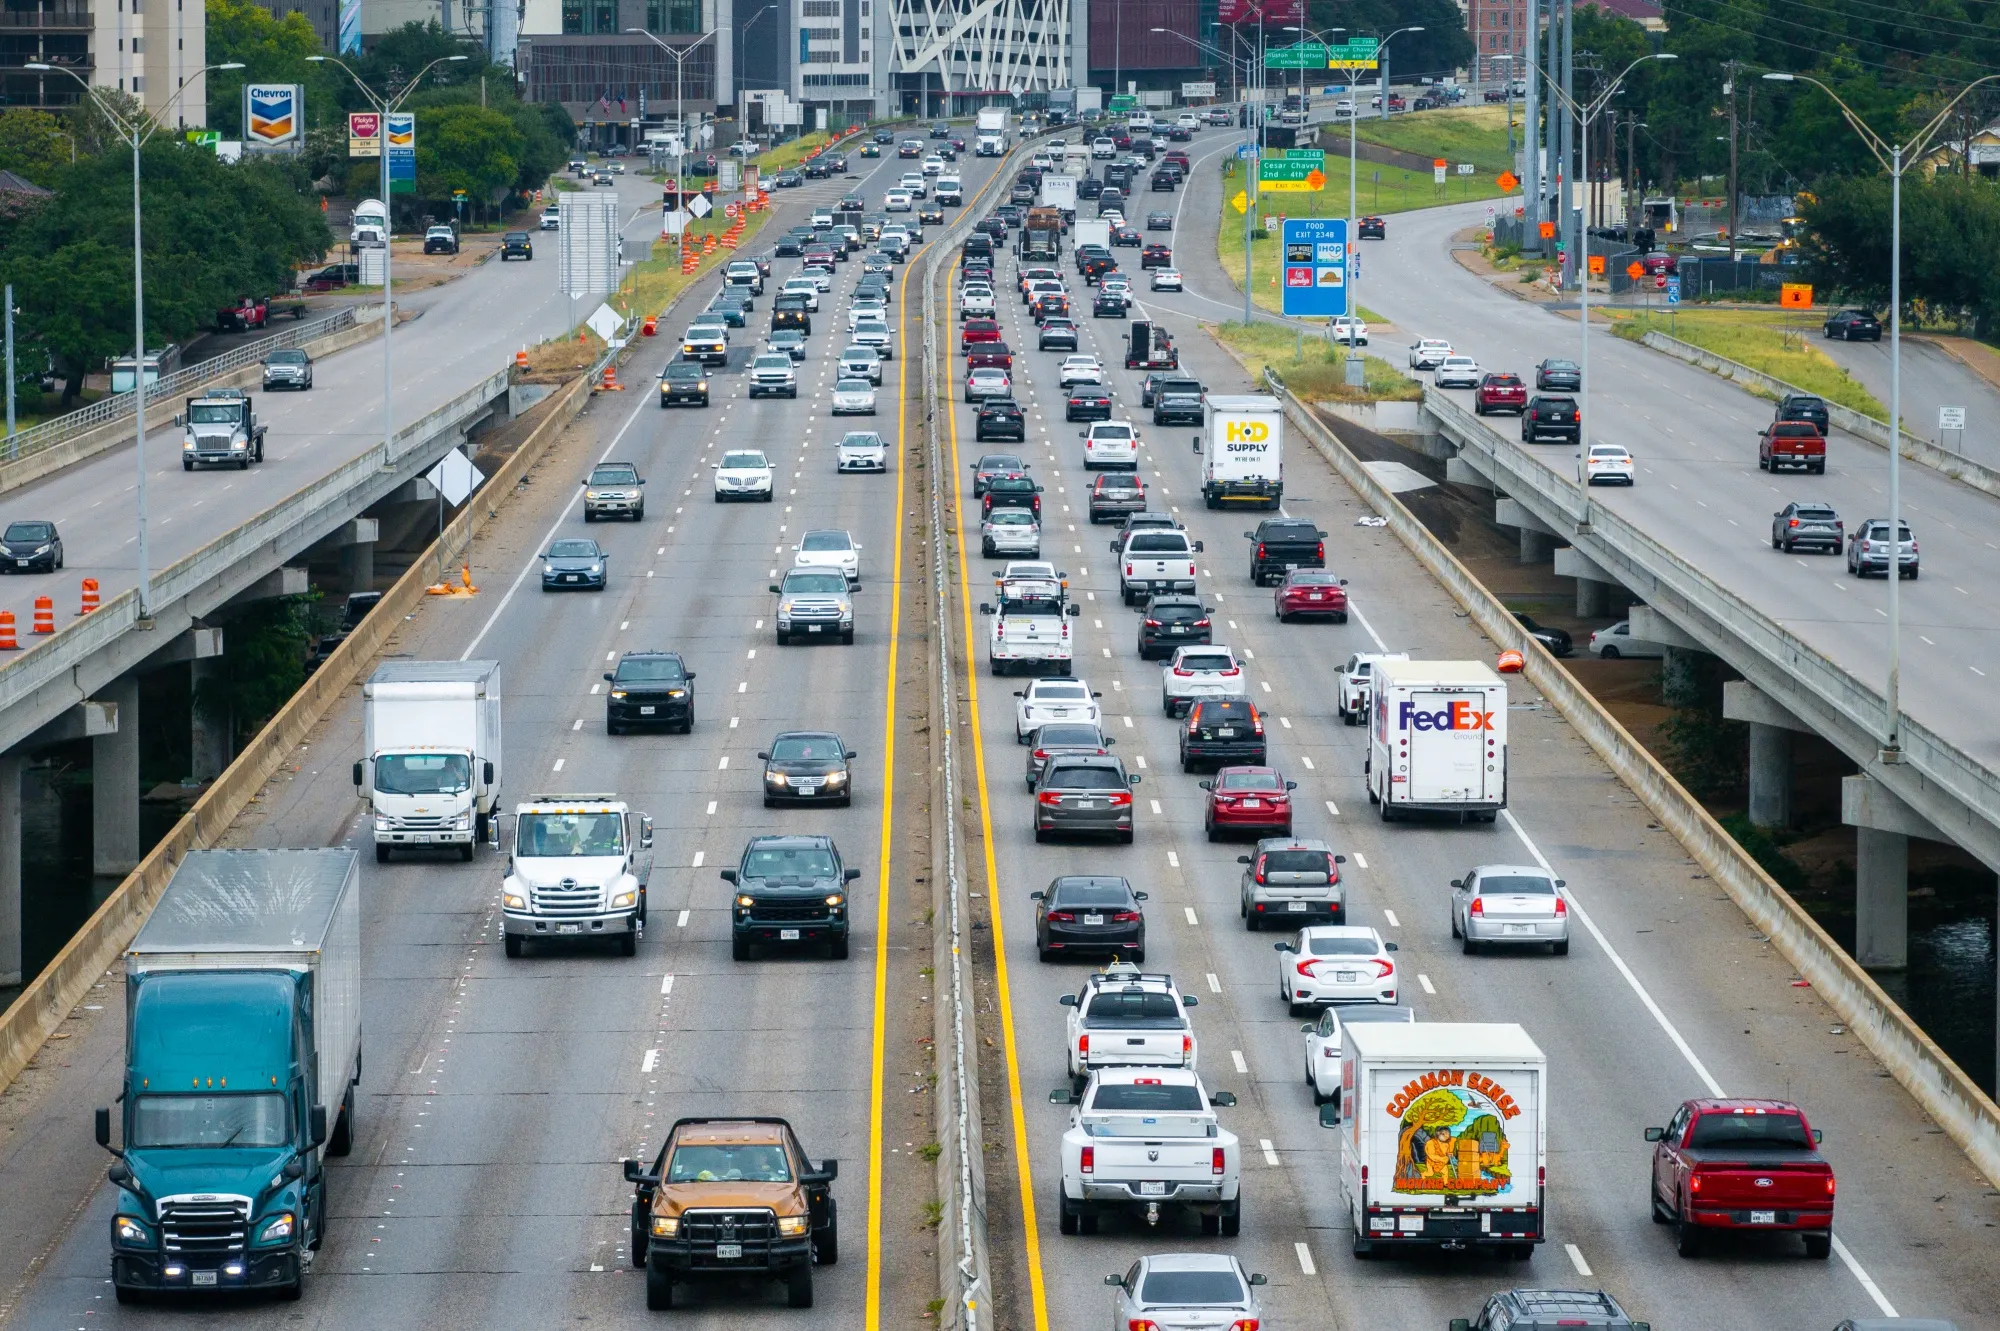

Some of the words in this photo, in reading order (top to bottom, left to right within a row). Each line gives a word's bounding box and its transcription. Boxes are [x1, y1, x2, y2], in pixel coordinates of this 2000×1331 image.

[251, 88, 292, 98] Chevron
[1227, 444, 1268, 452] SUPPLY
[1399, 702, 1495, 731] FedEx
[1453, 731, 1483, 741] Ground
[1386, 1069, 1465, 1119] COMMON
[1467, 1071, 1521, 1121] SENSE
[1396, 1177, 1444, 1190] MOVING
[1448, 1177, 1509, 1190] COMPANY
